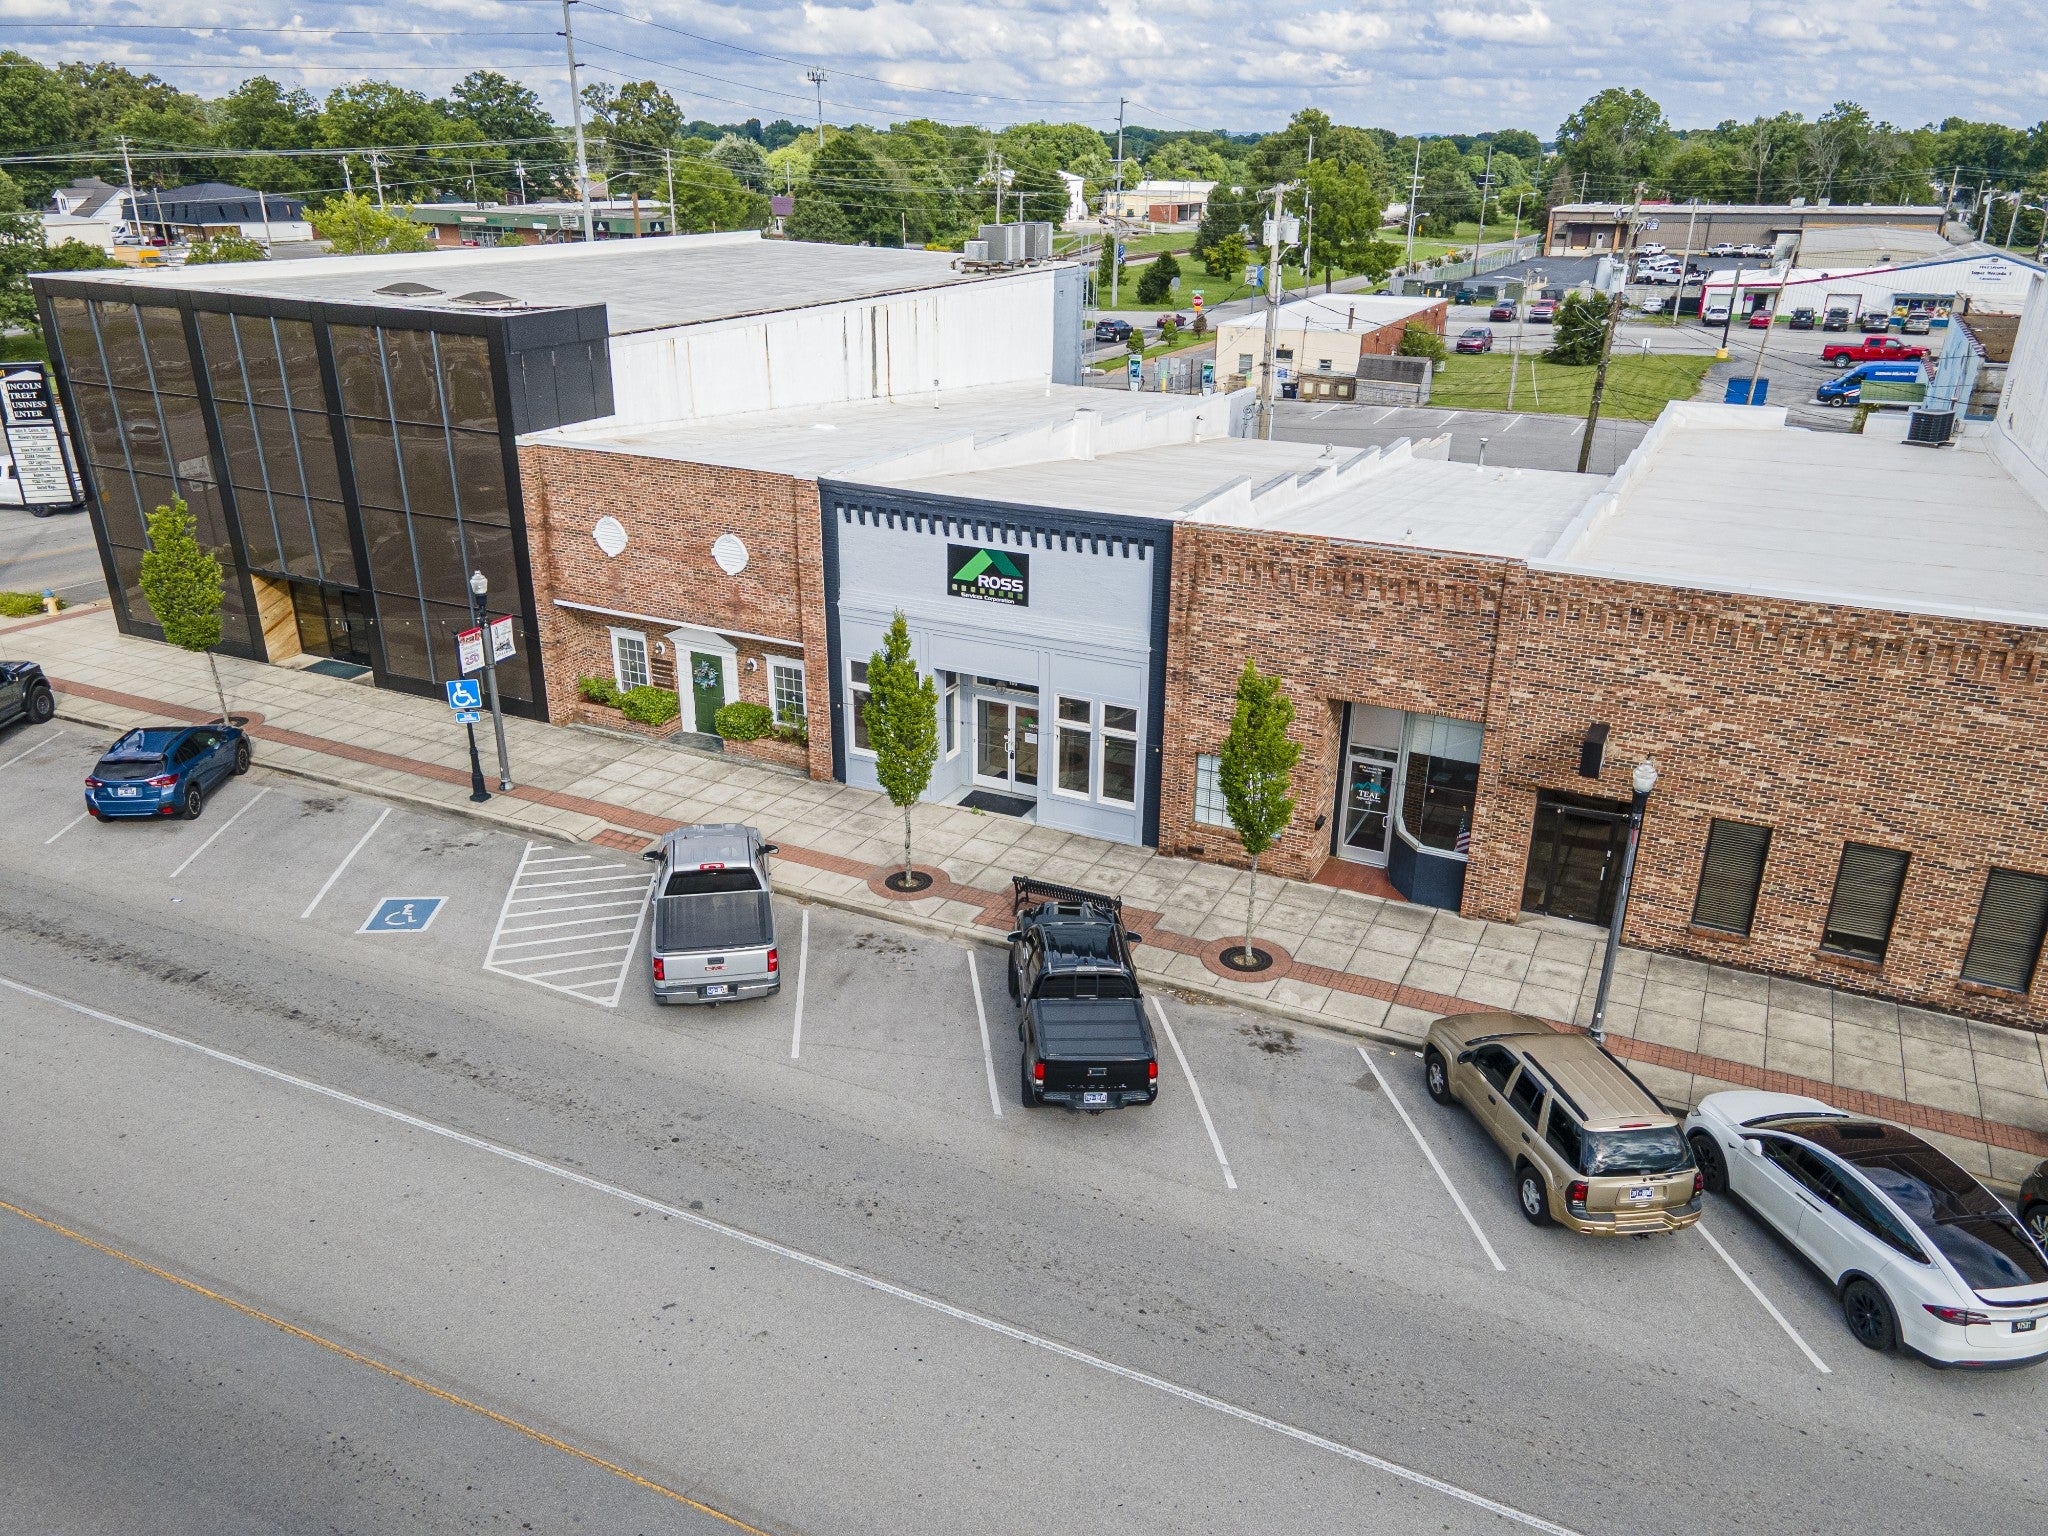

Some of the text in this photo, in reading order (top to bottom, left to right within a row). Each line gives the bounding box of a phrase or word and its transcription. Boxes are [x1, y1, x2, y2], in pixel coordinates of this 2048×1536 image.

[1, 382, 42, 390] INCOLN
[977, 574, 1024, 593] ROSS
[960, 591, 1015, 604] Services Corporation
[1358, 789, 1381, 800] TEAL
